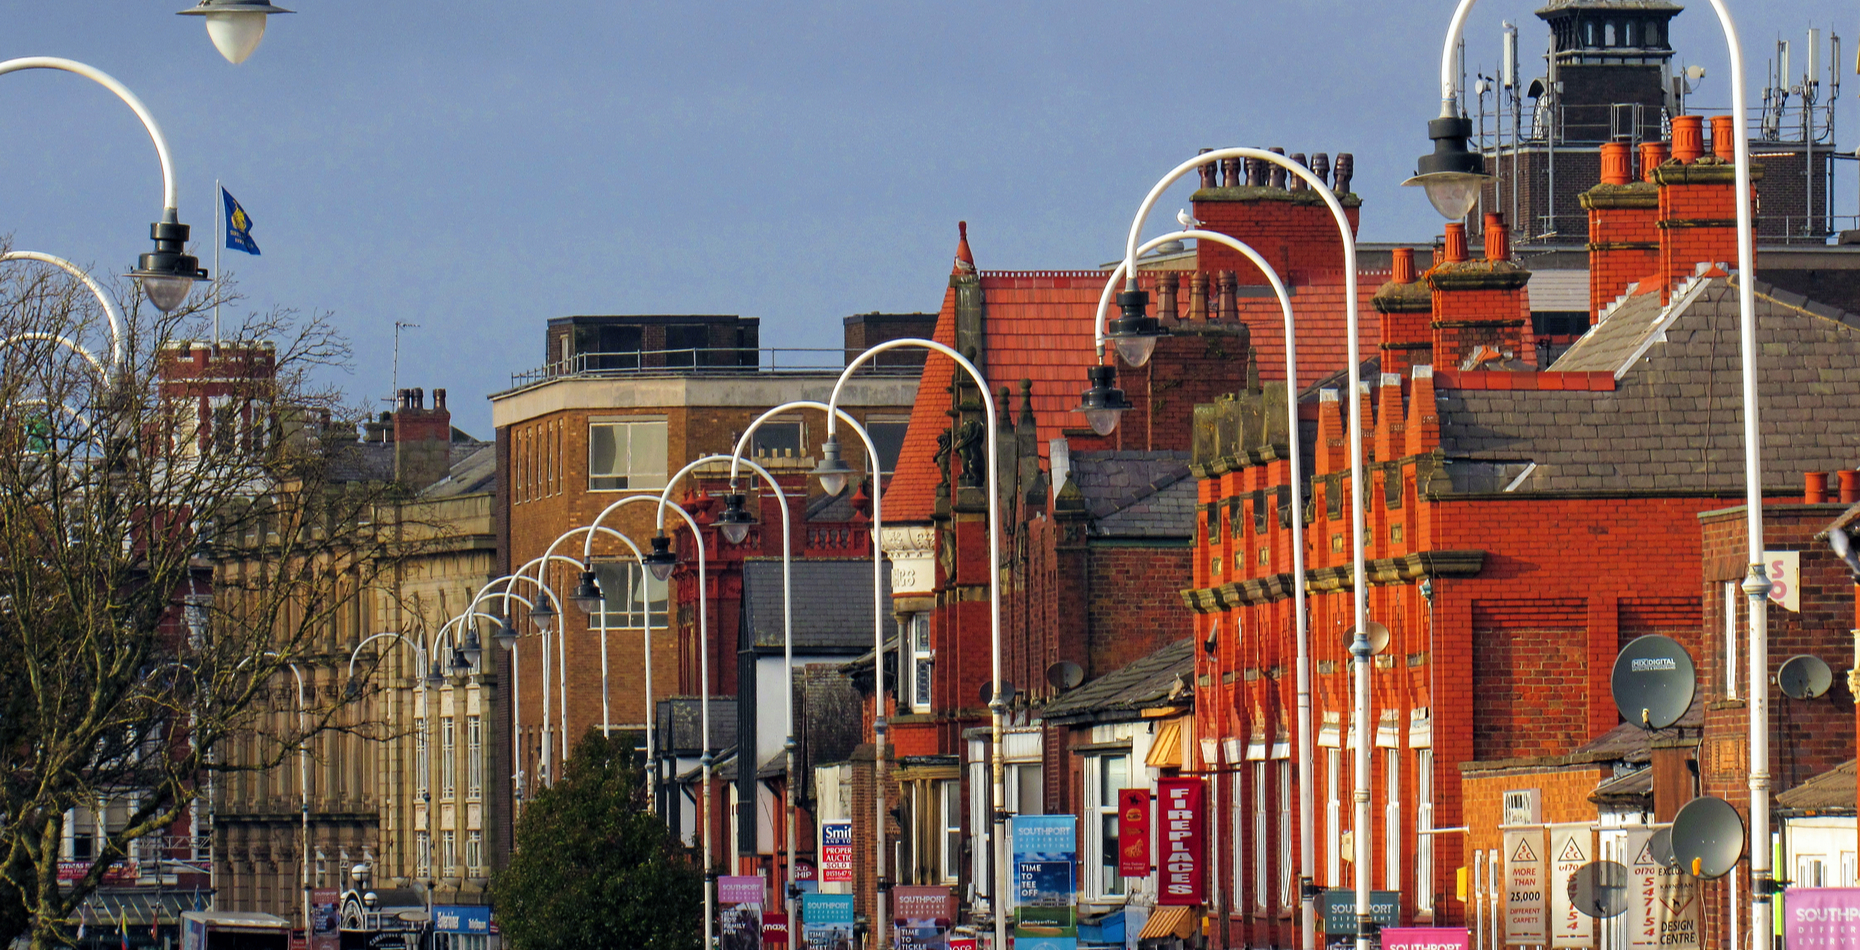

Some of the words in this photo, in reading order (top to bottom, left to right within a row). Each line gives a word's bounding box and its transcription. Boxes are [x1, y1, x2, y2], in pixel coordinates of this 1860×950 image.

[1018, 827, 1070, 836] SOUTHPORT
[1167, 788, 1194, 895] FIREPLACES
[1021, 864, 1041, 872] TIME
[1513, 868, 1536, 876] MORE
[1021, 881, 1036, 889] TEE
[1021, 889, 1038, 897] OFF
[1510, 891, 1540, 902] 25,000
[899, 895, 946, 903] SOUTHPORT
[1796, 908, 1860, 922] SOUTHP
[1661, 920, 1694, 932] DESIGN
[1660, 932, 1695, 945] CENTRE
